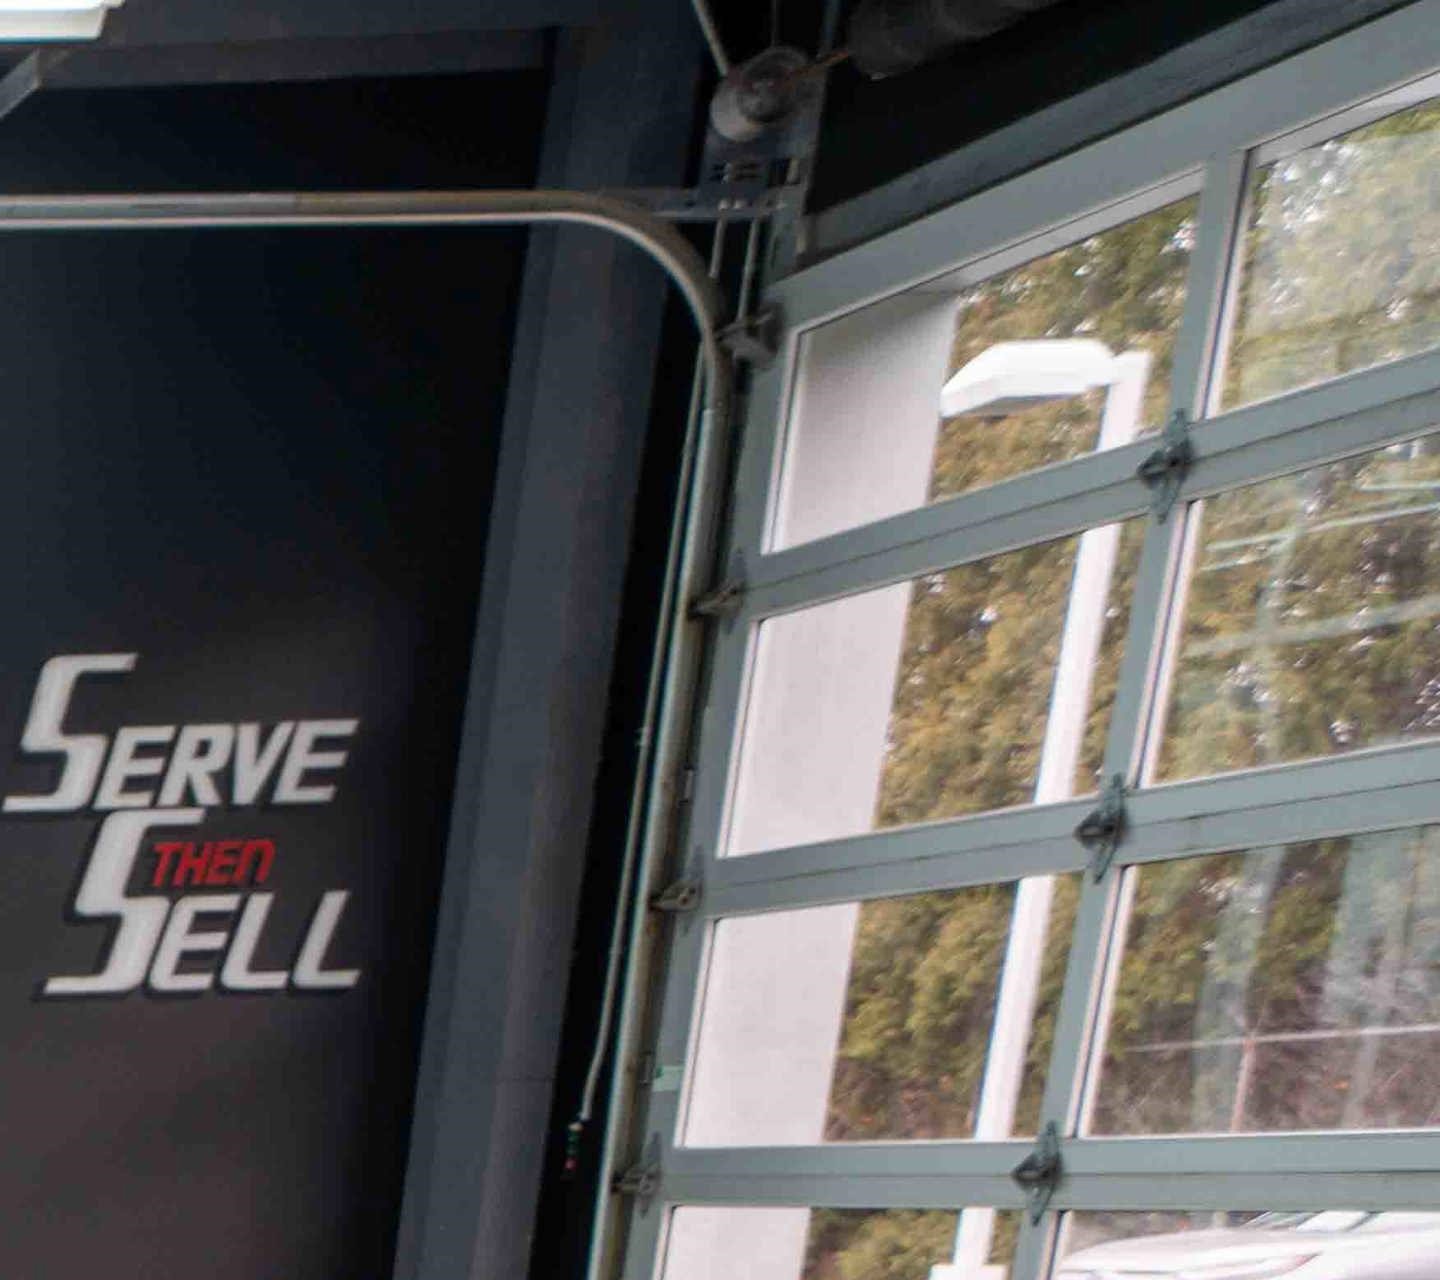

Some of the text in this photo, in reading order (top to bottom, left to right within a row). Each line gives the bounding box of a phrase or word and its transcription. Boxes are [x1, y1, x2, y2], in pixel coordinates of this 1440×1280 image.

[2, 653, 359, 813] SERVE
[43, 808, 362, 995] SELL
[152, 838, 276, 888] THEN
